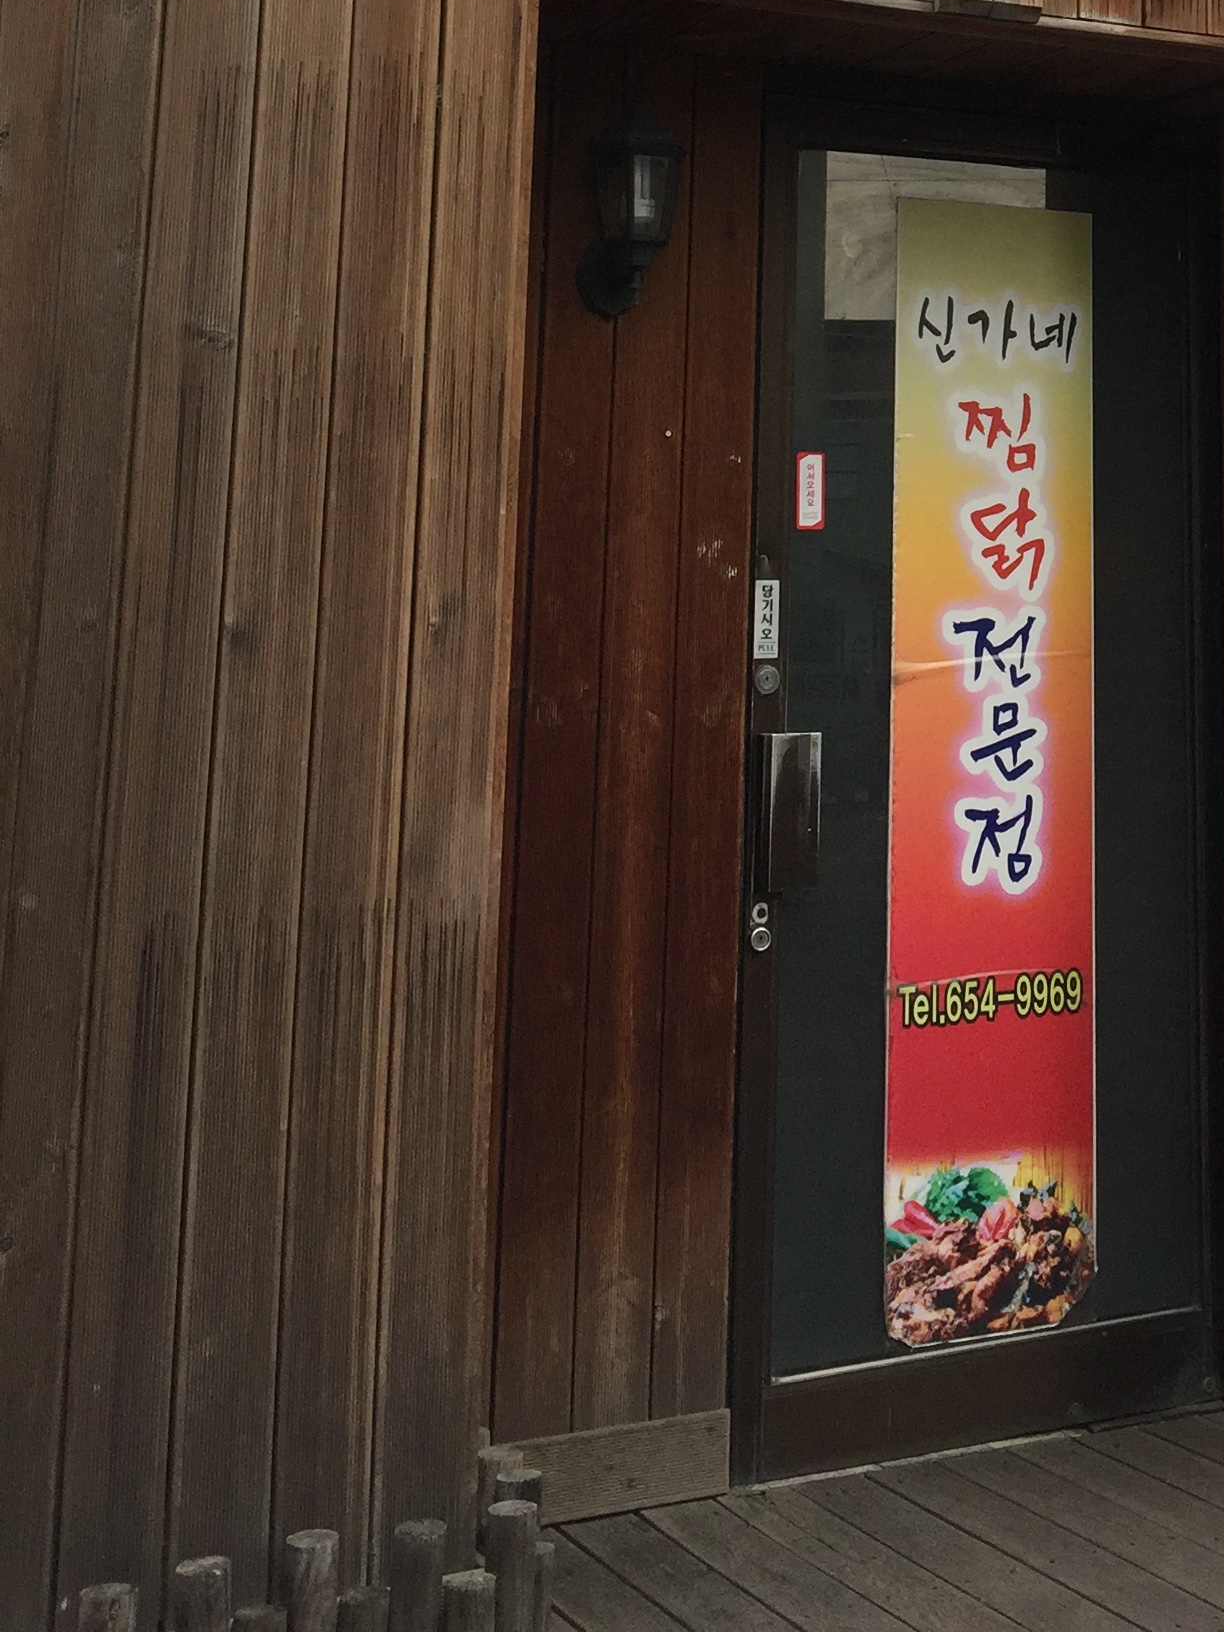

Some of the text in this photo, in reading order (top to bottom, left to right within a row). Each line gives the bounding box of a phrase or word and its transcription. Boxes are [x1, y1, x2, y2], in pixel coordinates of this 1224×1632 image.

[917, 295, 1077, 363] 신가네
[761, 584, 774, 640] 당기시오
[953, 393, 1046, 883] 찜닭 전문점
[899, 970, 1083, 1028] Tel.654-9969
